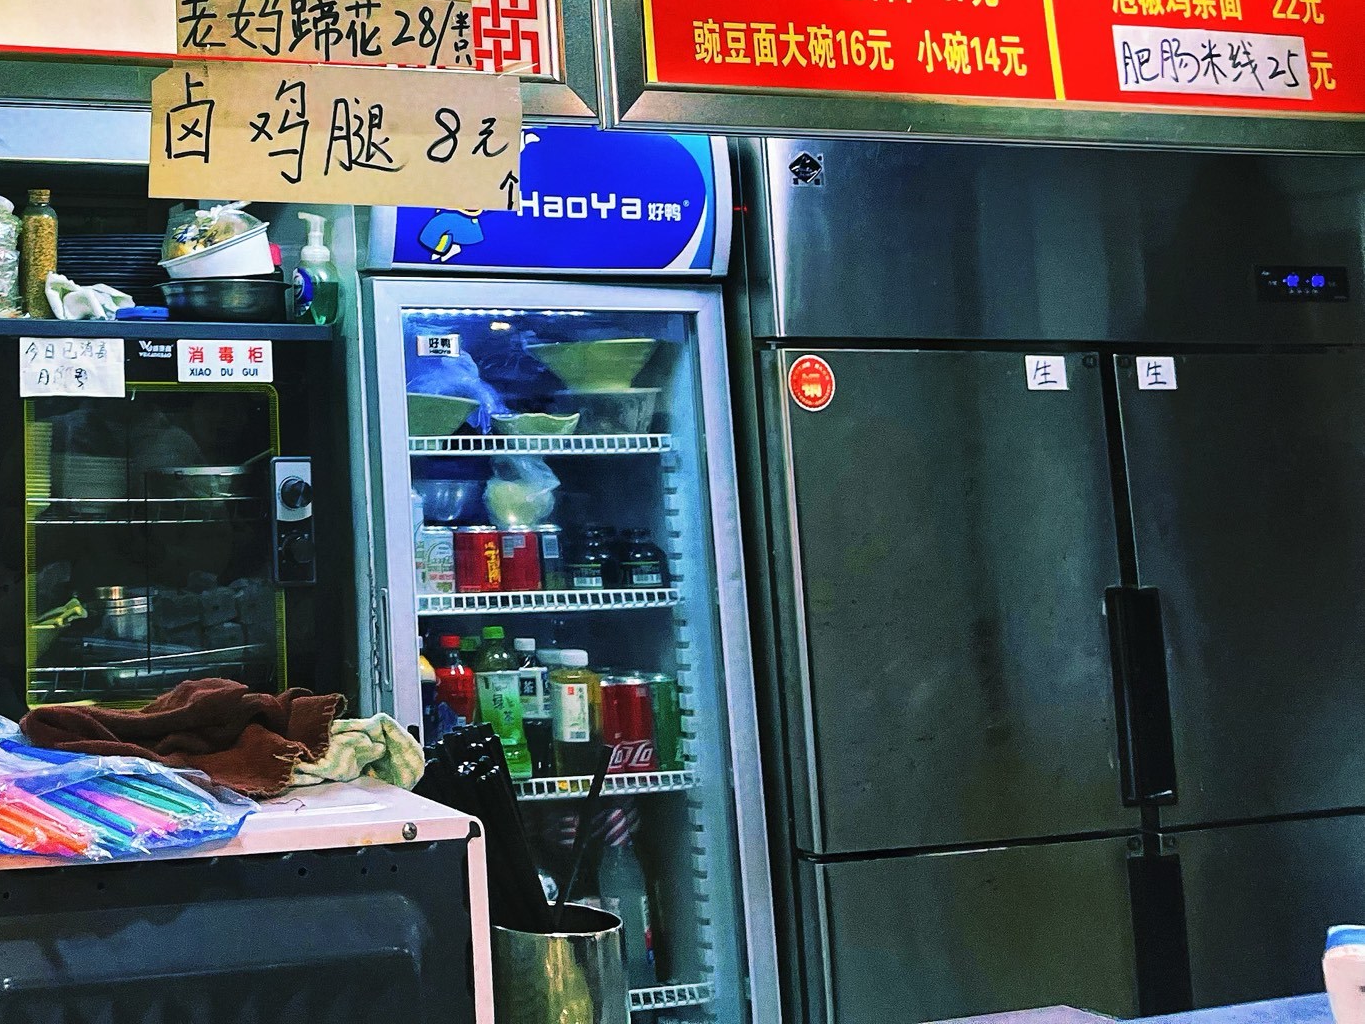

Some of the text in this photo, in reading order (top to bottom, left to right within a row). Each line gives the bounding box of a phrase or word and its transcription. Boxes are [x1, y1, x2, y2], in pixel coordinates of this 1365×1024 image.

[692, 17, 1028, 77] 豌豆面大碗16元 小碗14元
[1121, 38, 1300, 91] 肥肠米线25
[1309, 51, 1336, 91] 元
[165, 72, 407, 183] 卤鸡腿
[516, 190, 642, 221] HaoYa
[647, 202, 682, 222] 好鸭
[187, 346, 264, 364] 消毒柜
[188, 368, 259, 377] XIAO DU GUI
[1034, 360, 1057, 386] 生
[1146, 361, 1167, 385] 生
